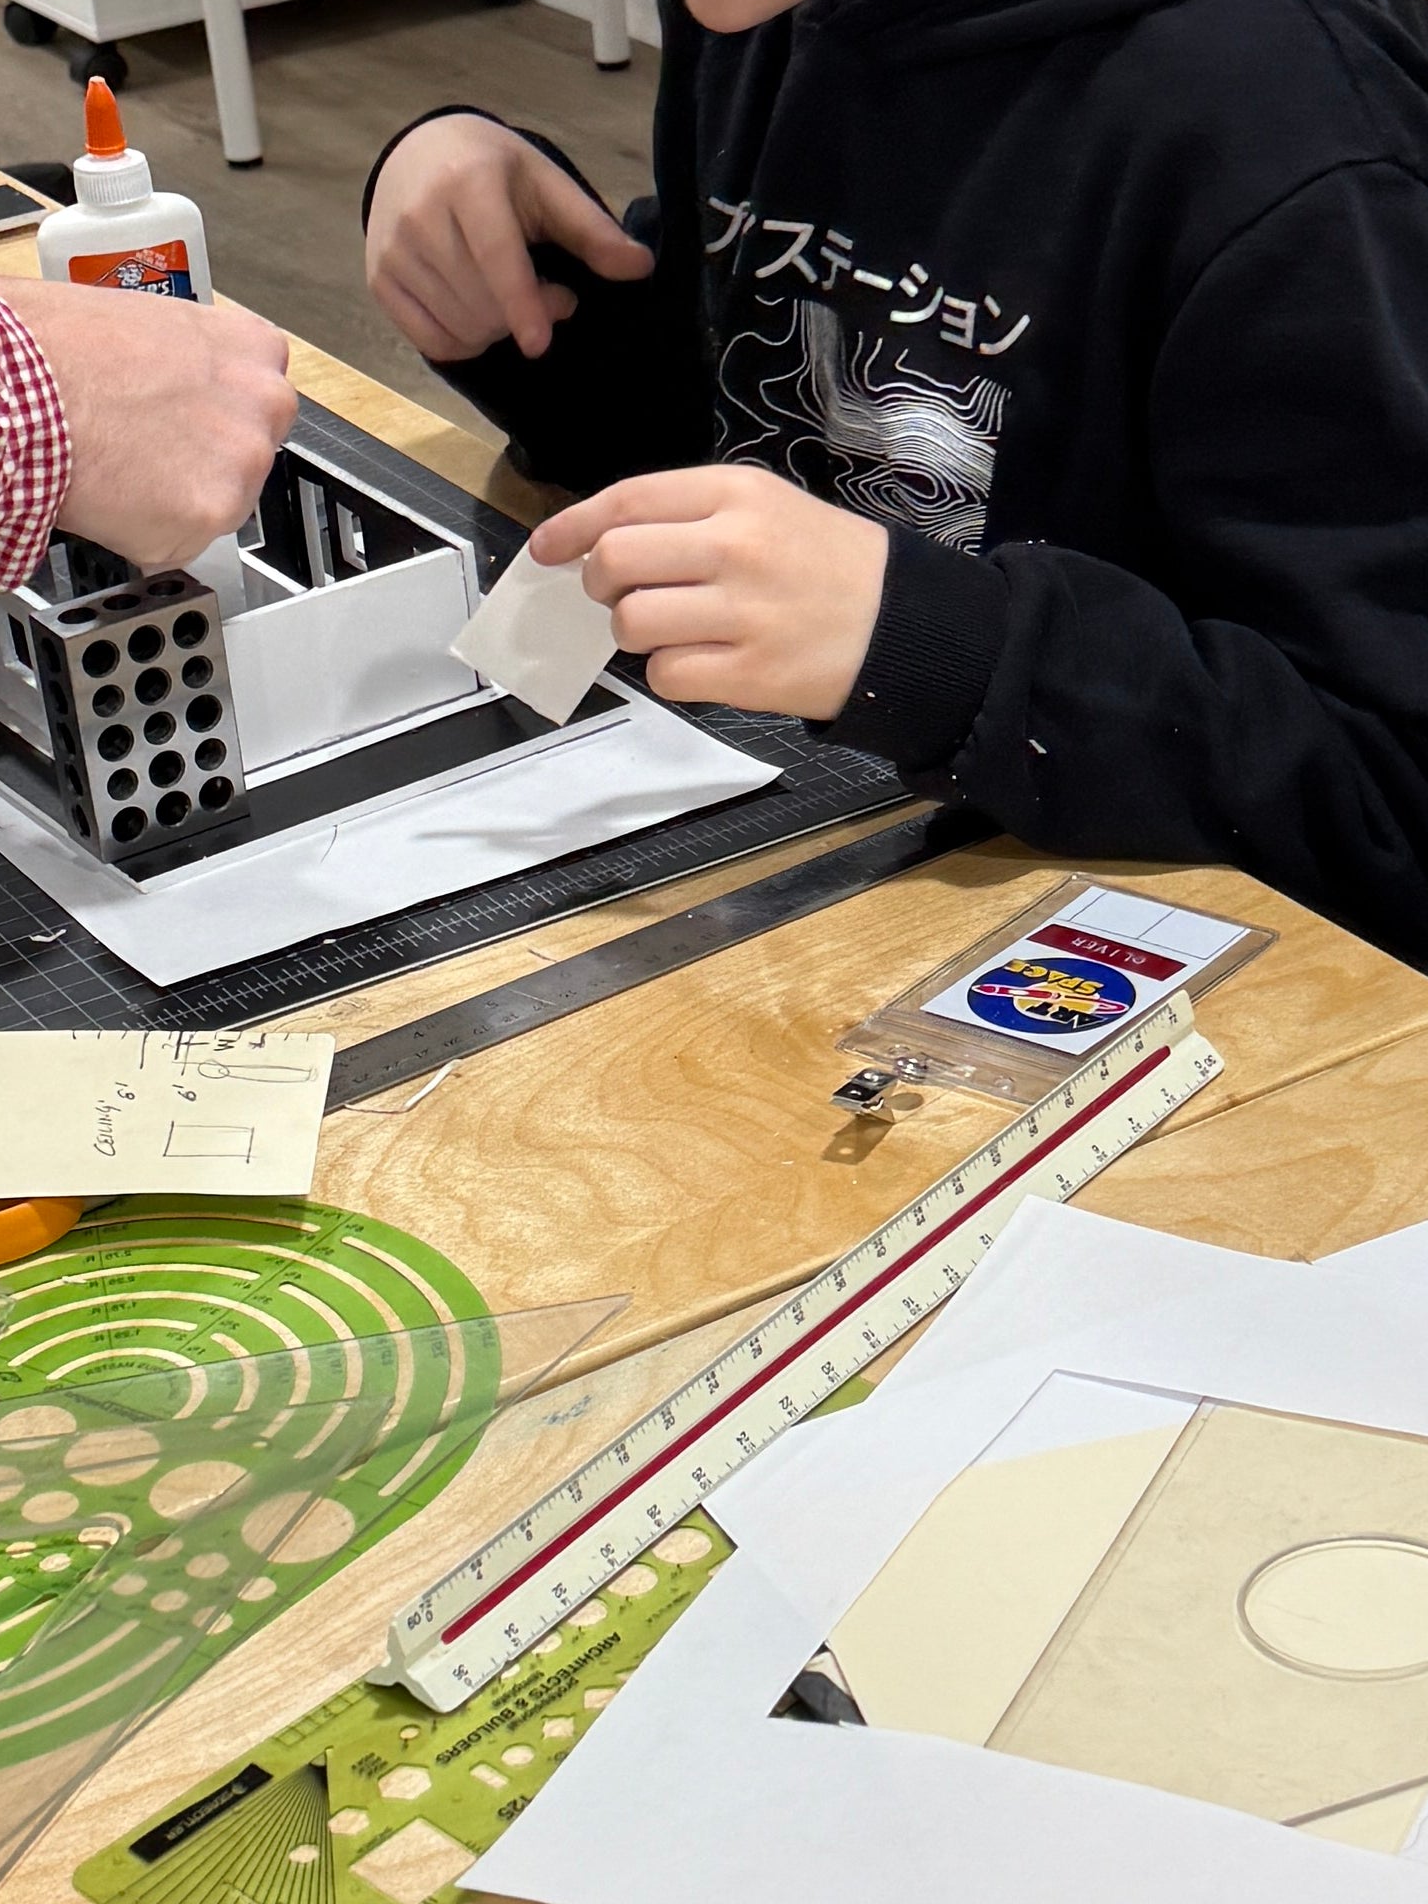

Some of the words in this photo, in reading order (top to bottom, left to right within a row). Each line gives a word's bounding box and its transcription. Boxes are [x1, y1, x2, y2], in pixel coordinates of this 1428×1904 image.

[1004, 959, 1103, 996] SPACE
[1030, 1004, 1106, 1029] ART
[529, 1631, 621, 1703] ARCHITECTS
[435, 1708, 516, 1764] BUILDERS
